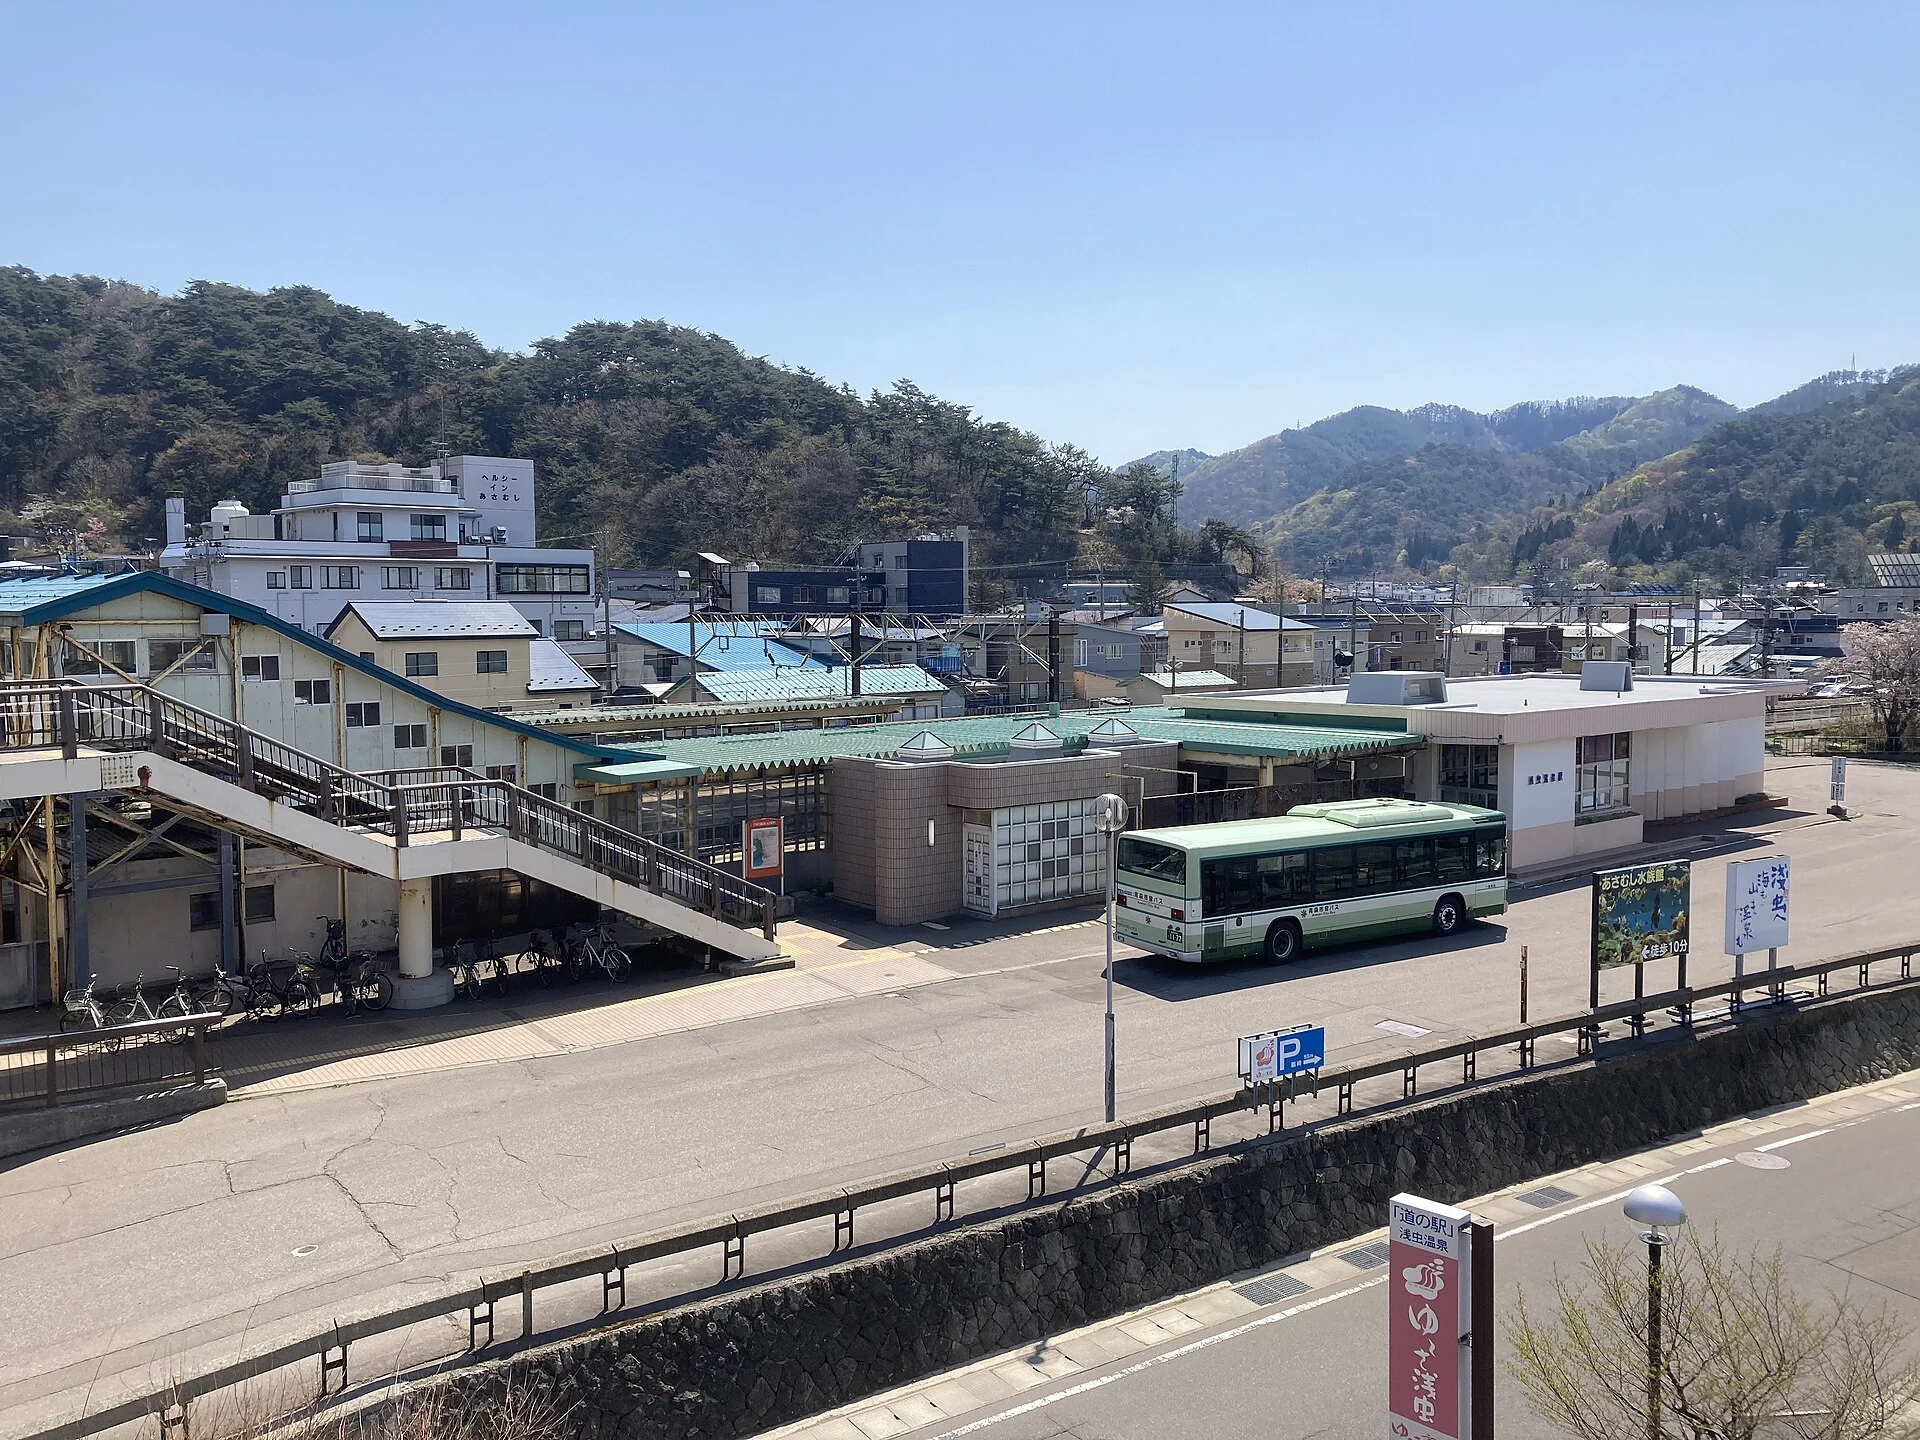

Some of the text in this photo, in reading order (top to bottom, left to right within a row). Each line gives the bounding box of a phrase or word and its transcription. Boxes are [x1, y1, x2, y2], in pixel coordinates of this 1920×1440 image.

[481, 474, 518, 482] ヘルシー
[479, 492, 520, 502] あさむし
[1601, 868, 1665, 890] あさむし水族館
[1650, 938, 1688, 957] 徒歩10分
[1279, 1038, 1301, 1071] P
[1394, 1205, 1454, 1238] 「道の駅」
[1399, 1226, 1449, 1253] 浅虫温泉
